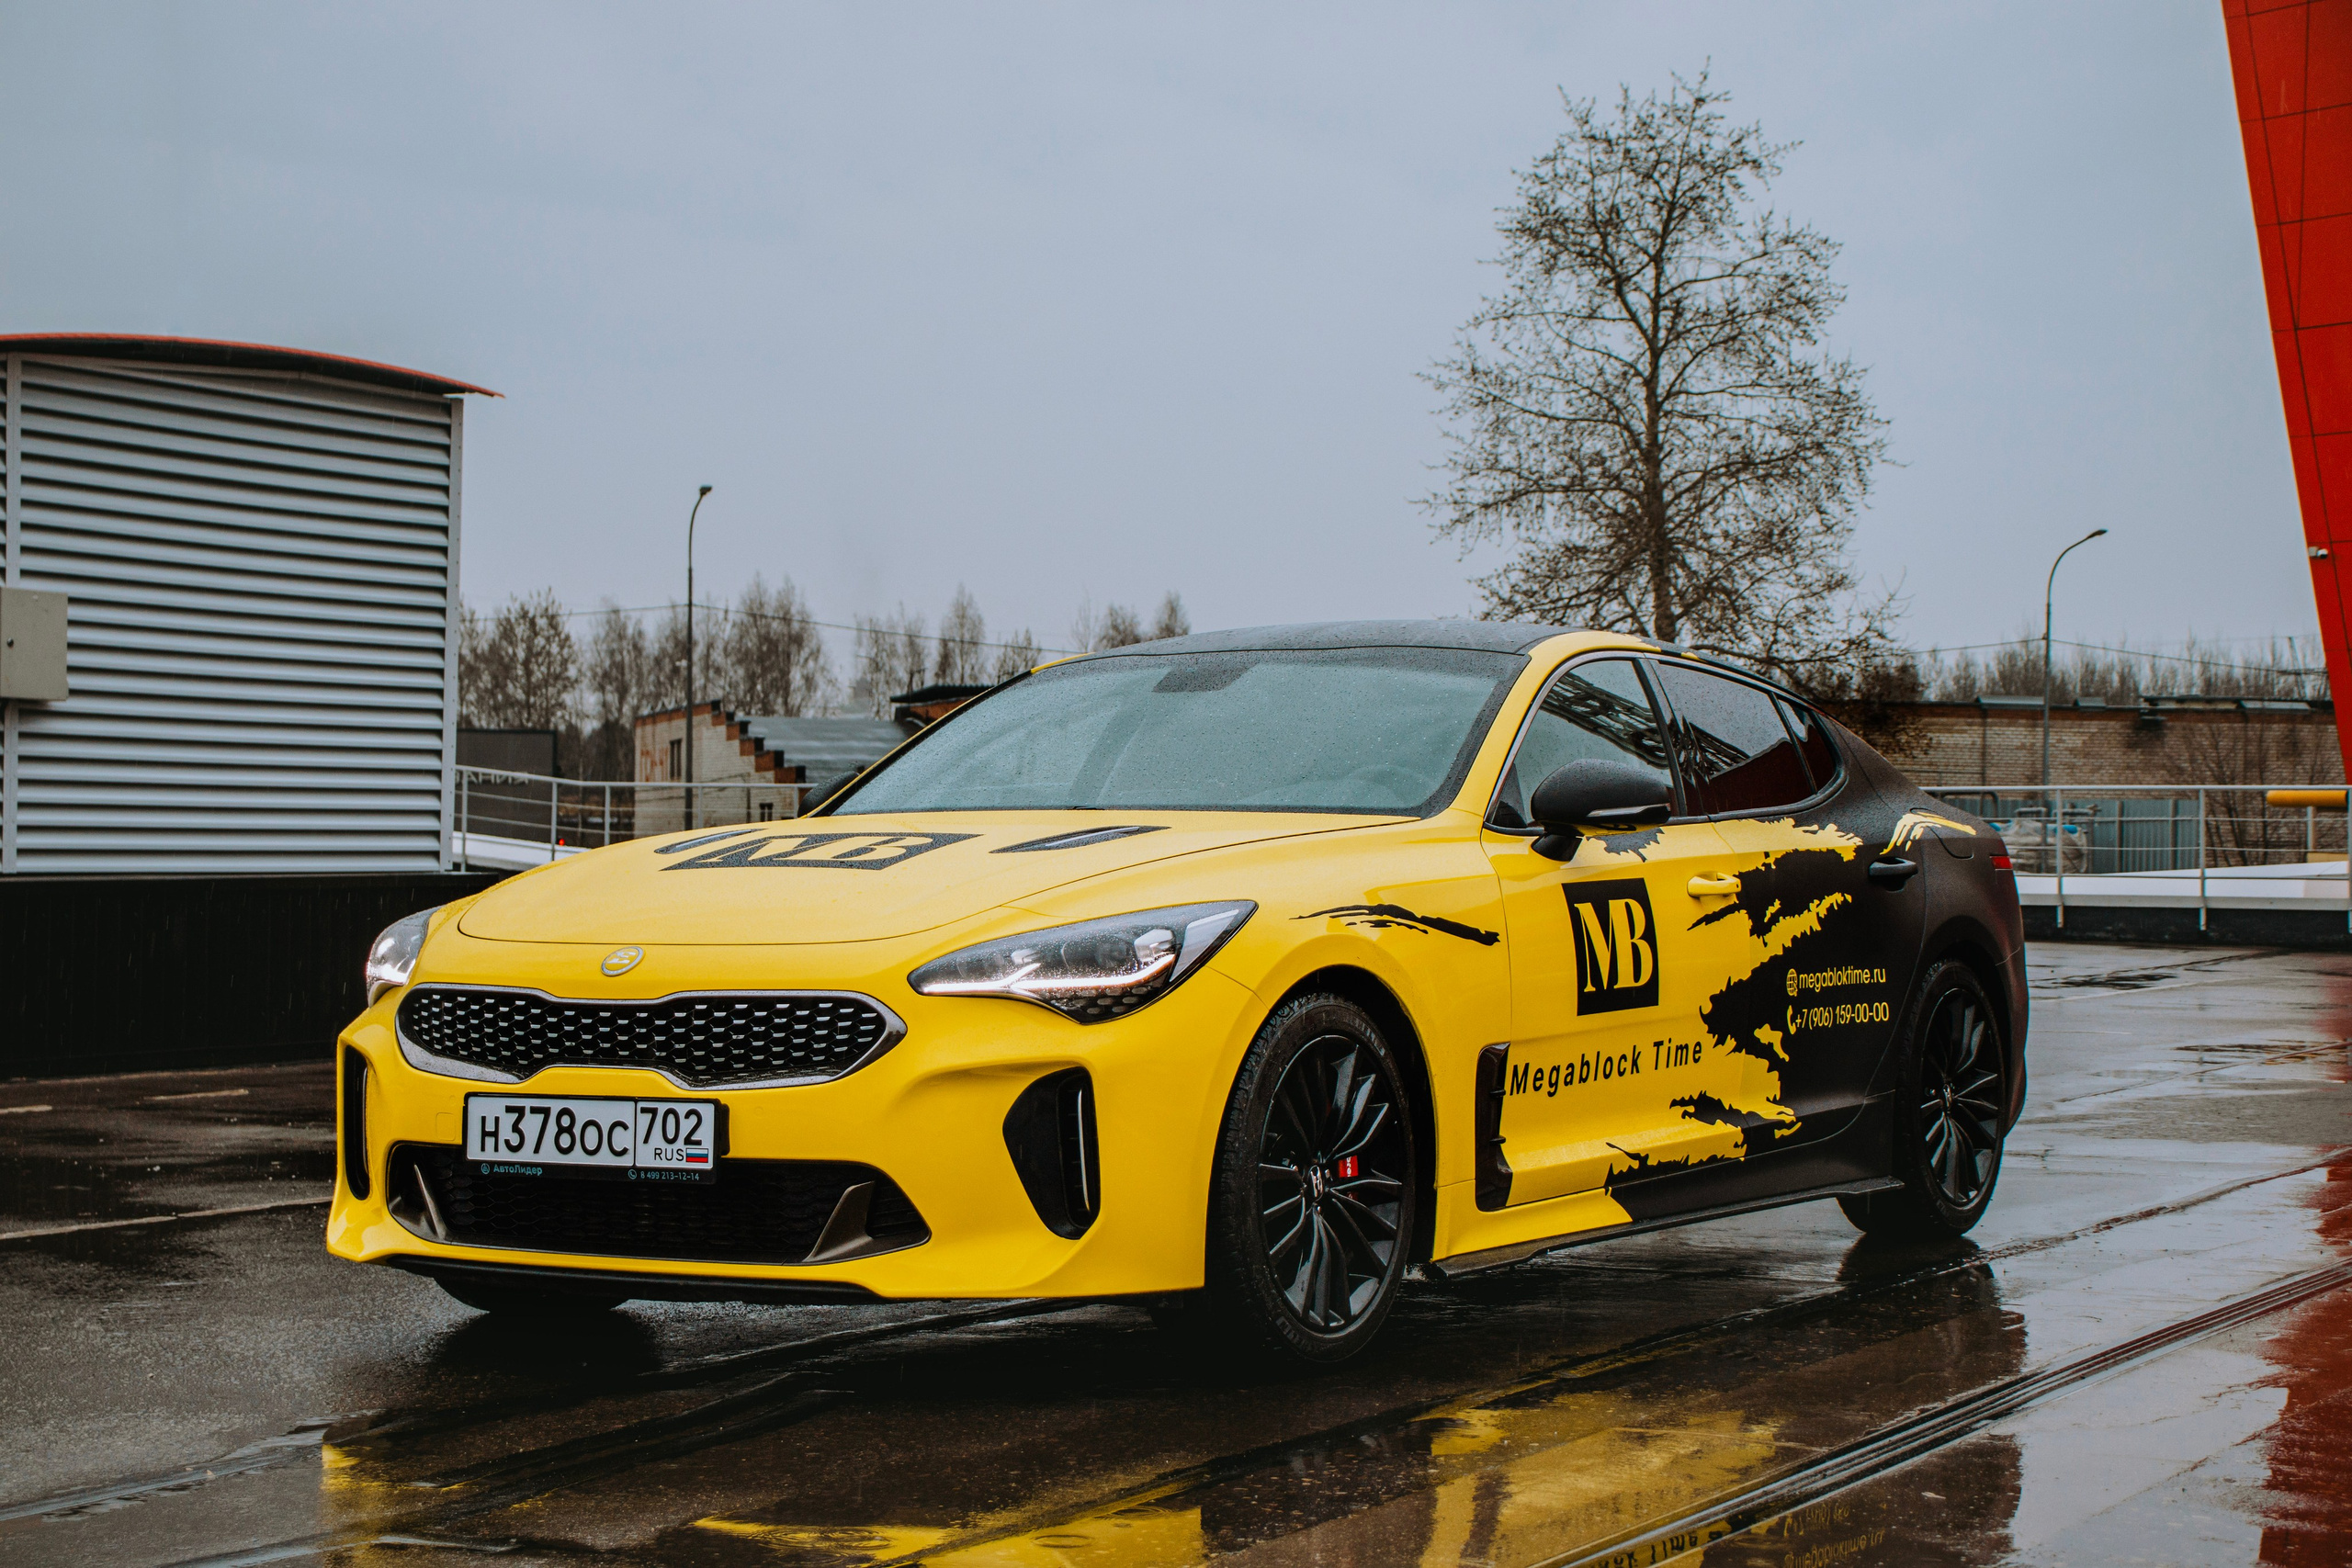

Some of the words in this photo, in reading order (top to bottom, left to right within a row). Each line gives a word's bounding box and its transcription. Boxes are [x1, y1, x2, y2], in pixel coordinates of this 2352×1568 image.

[1574, 898, 1653, 992] MB
[1799, 965, 1886, 992] megabloktime.ru
[1795, 1009, 1808, 1028] +7
[1809, 1007, 1834, 1030] (906)
[1836, 1002, 1890, 1024] 159-00-00
[1510, 1044, 1642, 1098] Megablock
[1653, 1038, 1702, 1071] Time
[640, 1106, 703, 1145] 702
[654, 1147, 684, 1161] RUS
[493, 1164, 543, 1176] АвтоЛидер
[640, 1171, 646, 1179] 8
[647, 1171, 660, 1179] 499
[662, 1171, 699, 1180] 213-12-14
